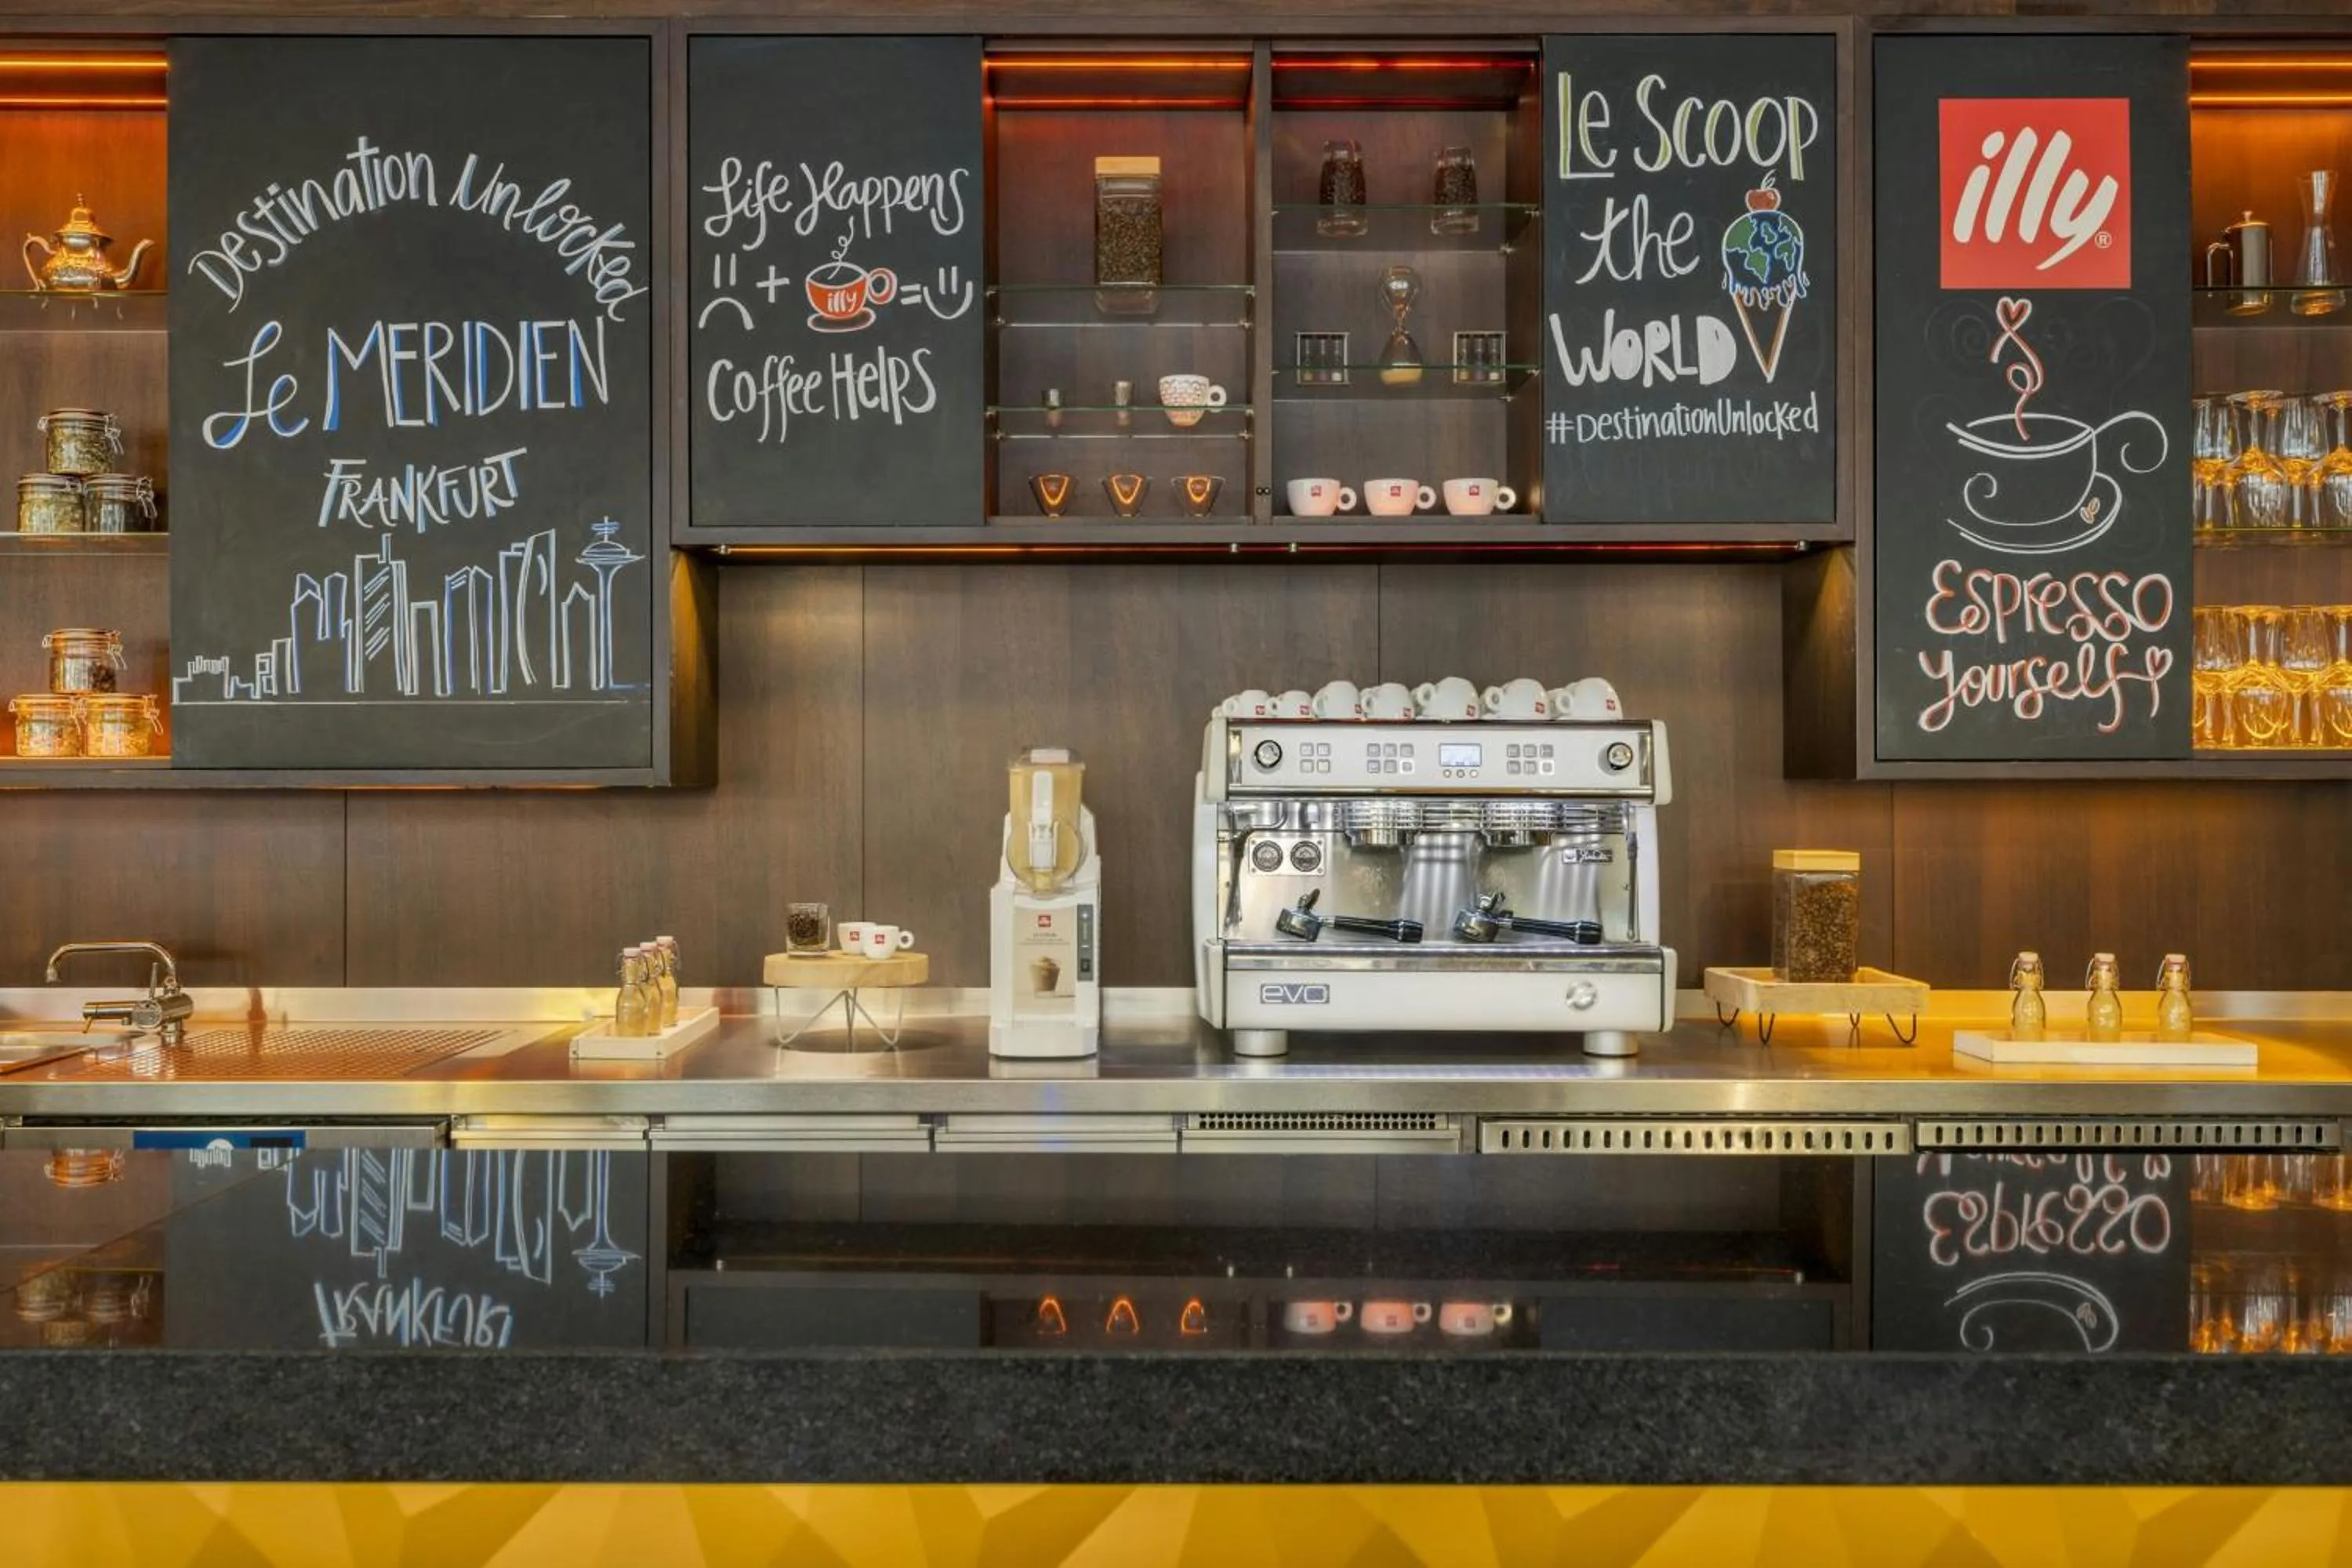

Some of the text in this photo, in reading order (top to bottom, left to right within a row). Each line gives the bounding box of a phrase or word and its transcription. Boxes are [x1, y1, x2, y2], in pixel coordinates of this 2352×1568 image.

[1558, 72, 1818, 181] Le Scoop
[188, 136, 648, 322] Destination Unlocked
[702, 157, 969, 250] Life Happens
[1575, 194, 1700, 285] the
[1953, 126, 2118, 270] illy
[827, 291, 858, 313] illy
[1548, 309, 1737, 388] WORLD
[202, 316, 608, 449] Le MERIDIEN
[707, 346, 937, 443] Coffee Helps
[318, 447, 528, 533] FRANKFURT
